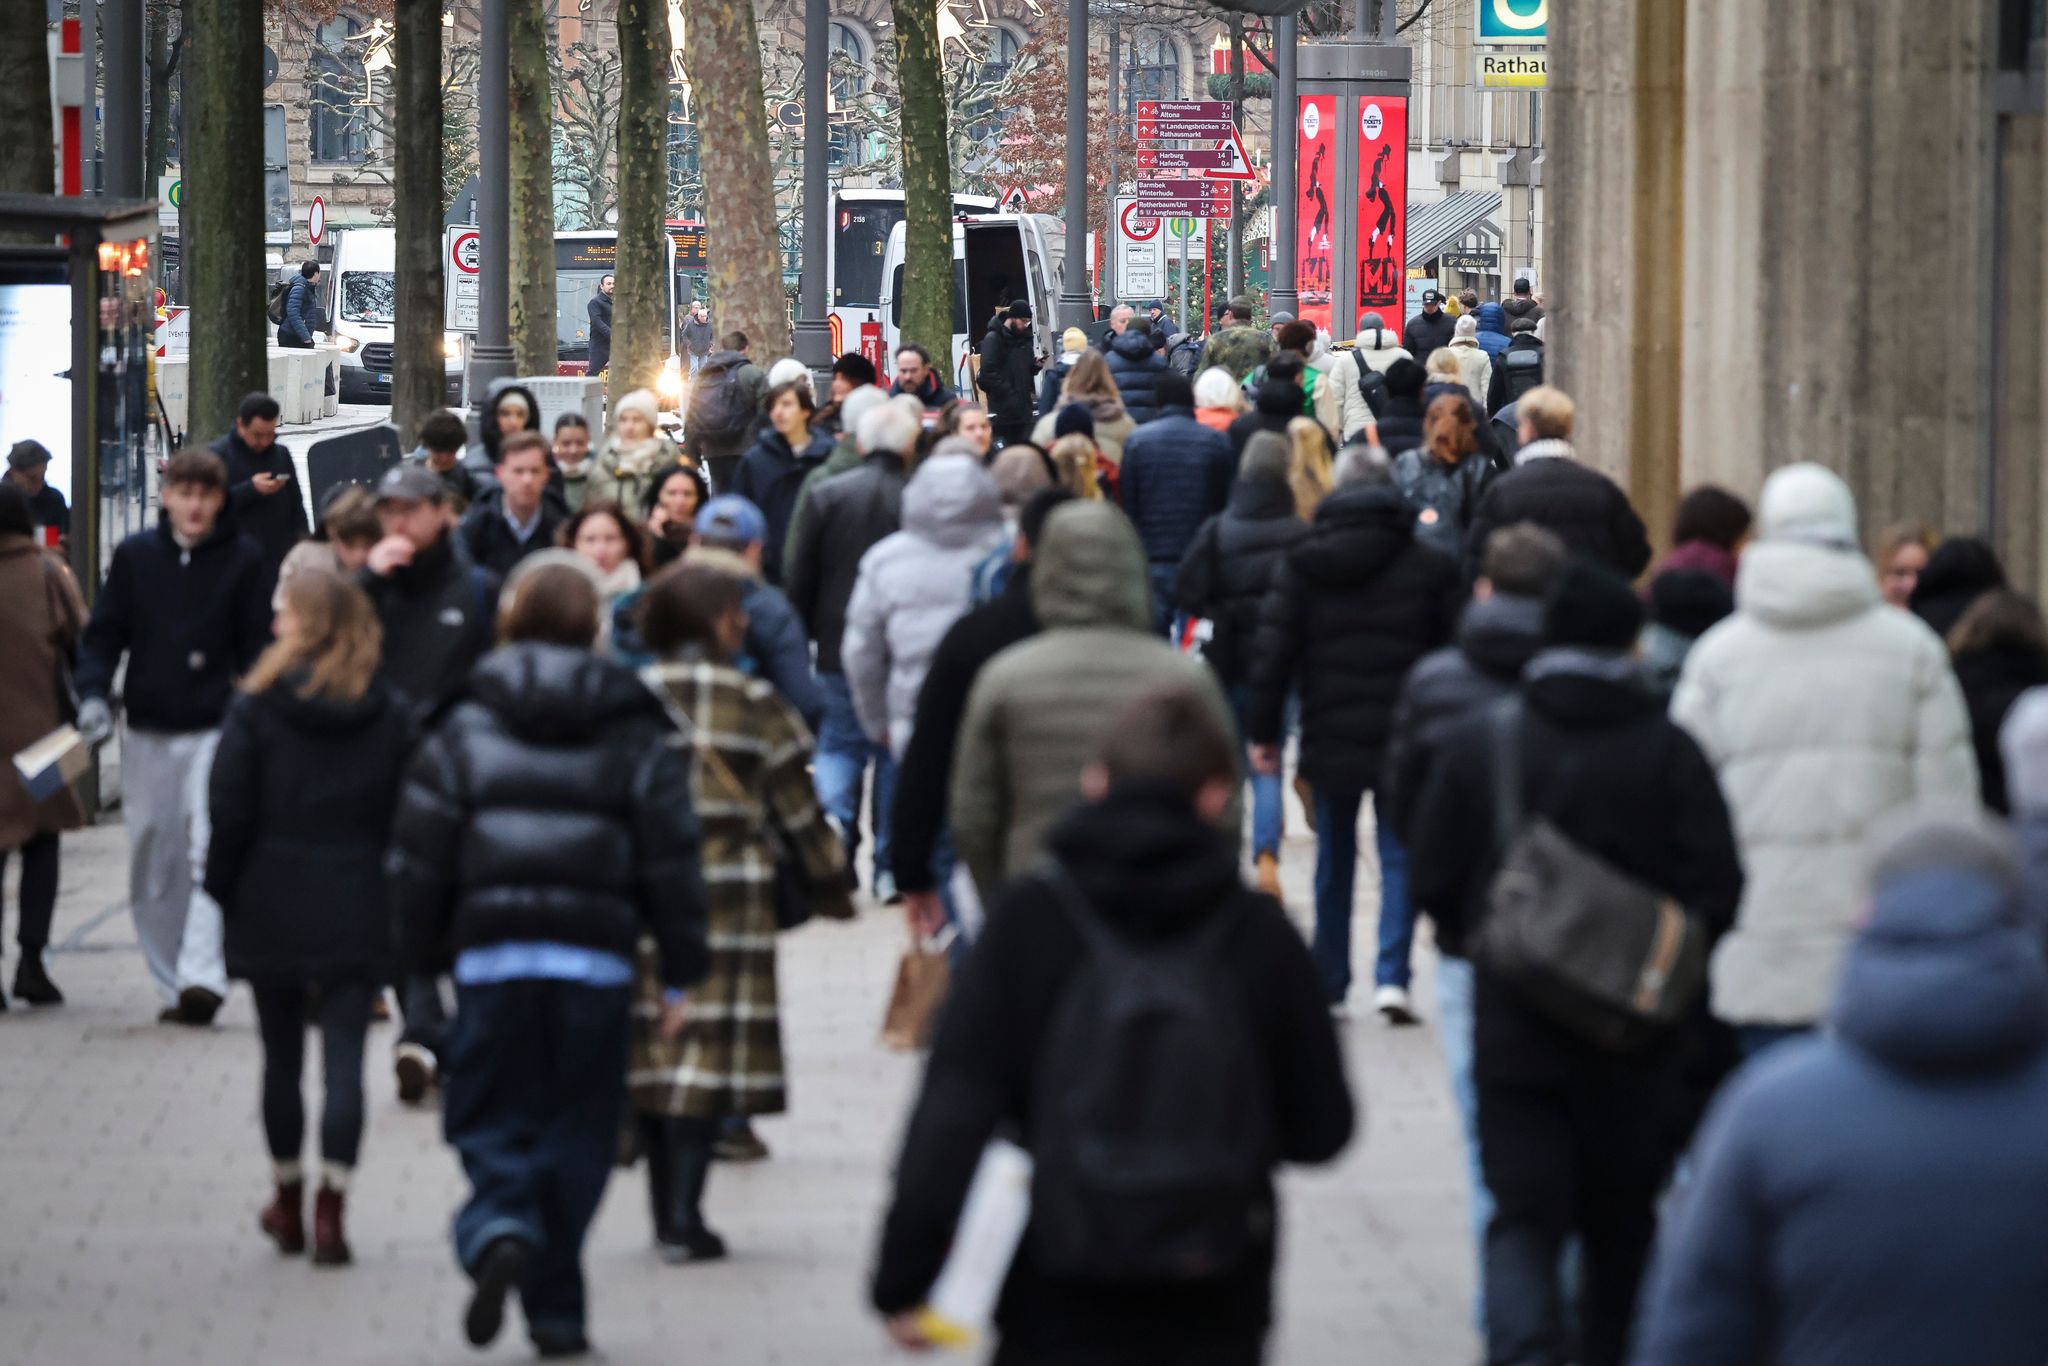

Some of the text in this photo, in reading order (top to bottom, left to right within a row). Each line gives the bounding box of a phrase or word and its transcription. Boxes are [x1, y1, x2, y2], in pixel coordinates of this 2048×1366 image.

[1160, 103, 1201, 111] Wilhelmsburg
[1166, 123, 1220, 131] Landungsbrücken
[1159, 152, 1184, 160] Harburg
[1159, 160, 1189, 168] HafenCity
[1152, 209, 1193, 217] Jungfernstieg
[875, 241, 881, 254] 3
[1460, 257, 1491, 266] Tchibo
[1362, 258, 1397, 294] MJ
